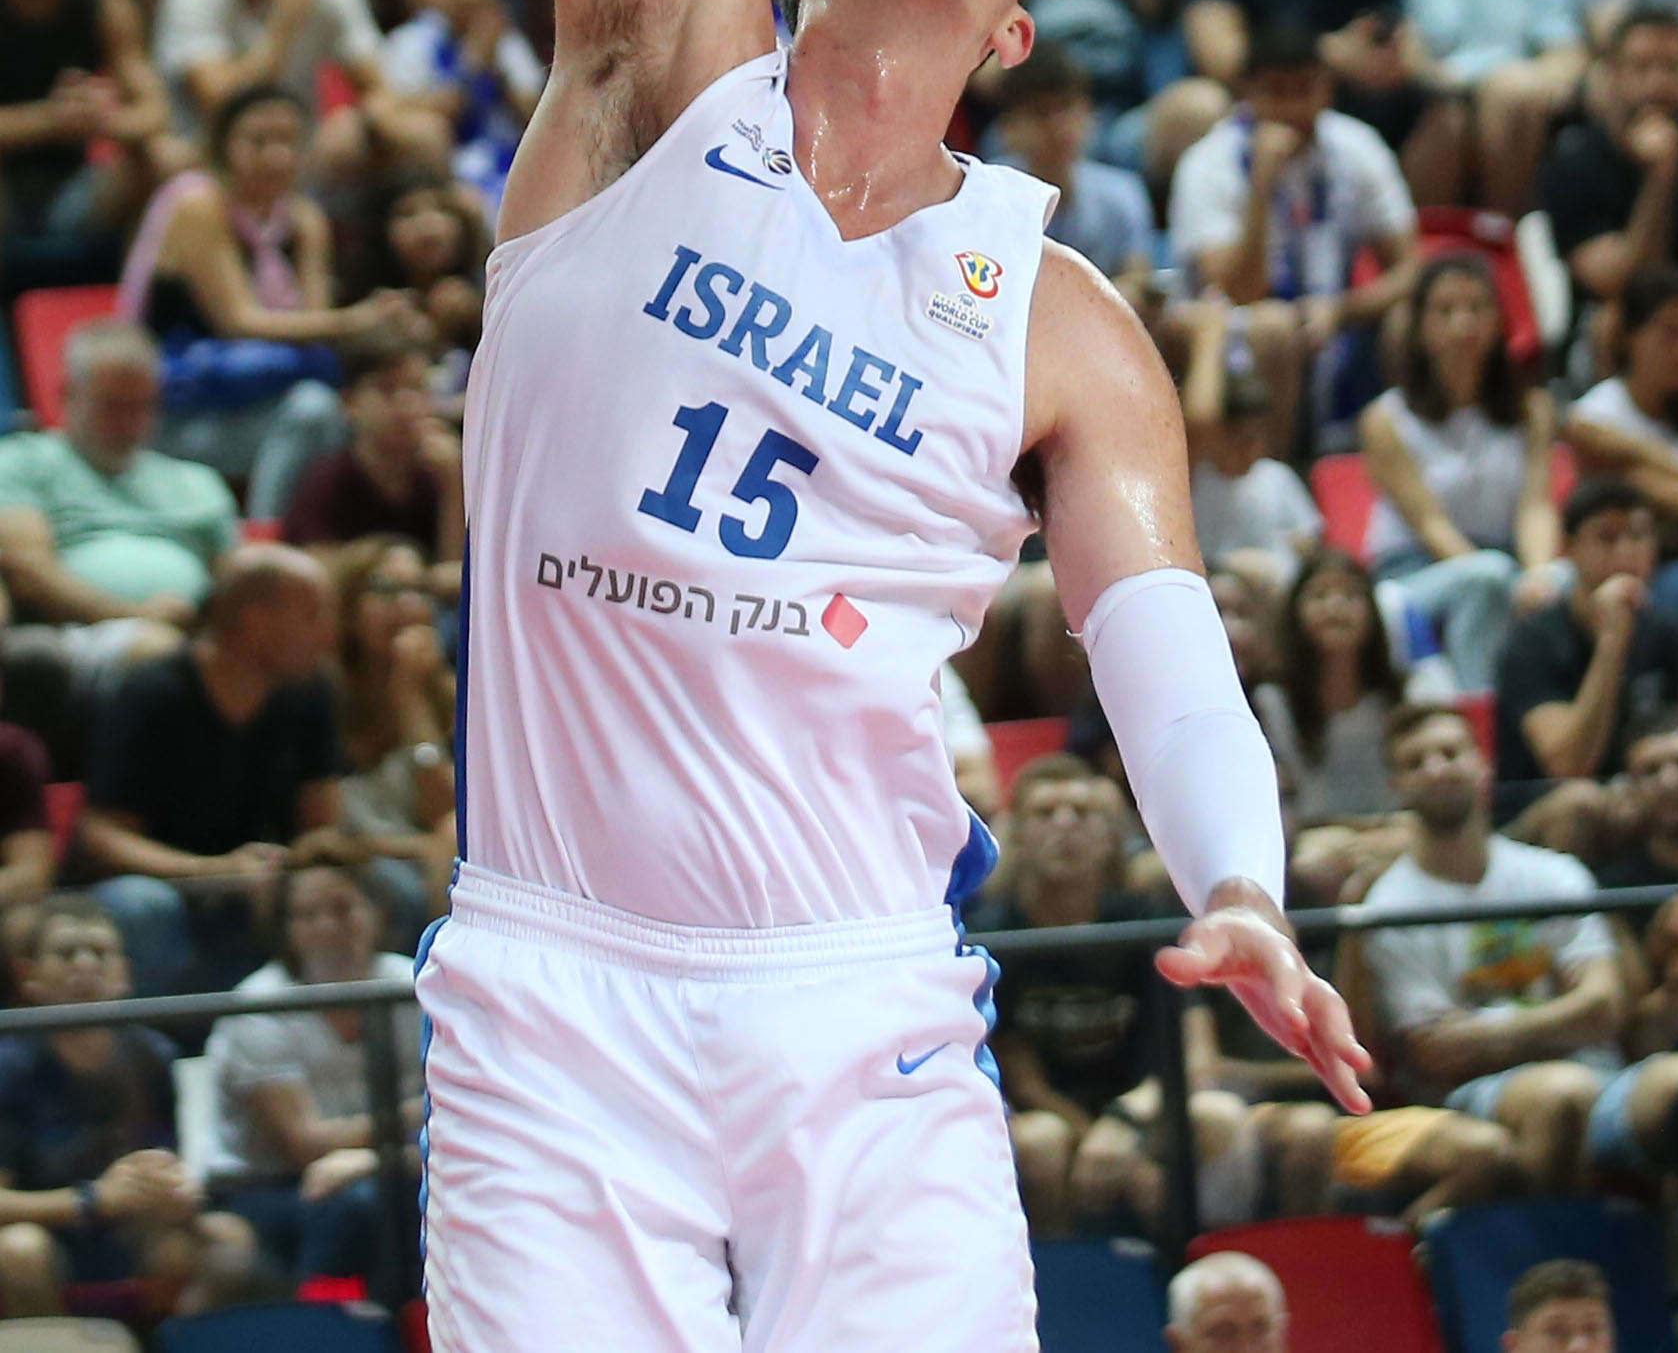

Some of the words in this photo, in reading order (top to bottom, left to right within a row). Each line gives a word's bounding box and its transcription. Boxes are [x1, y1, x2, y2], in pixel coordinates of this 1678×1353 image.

[643, 244, 923, 456] ISRAEL
[932, 299, 968, 322] WORLD
[968, 317, 990, 332] CUP
[637, 400, 820, 560] 15
[537, 552, 716, 622] הפועלים
[729, 593, 810, 635] בנק
